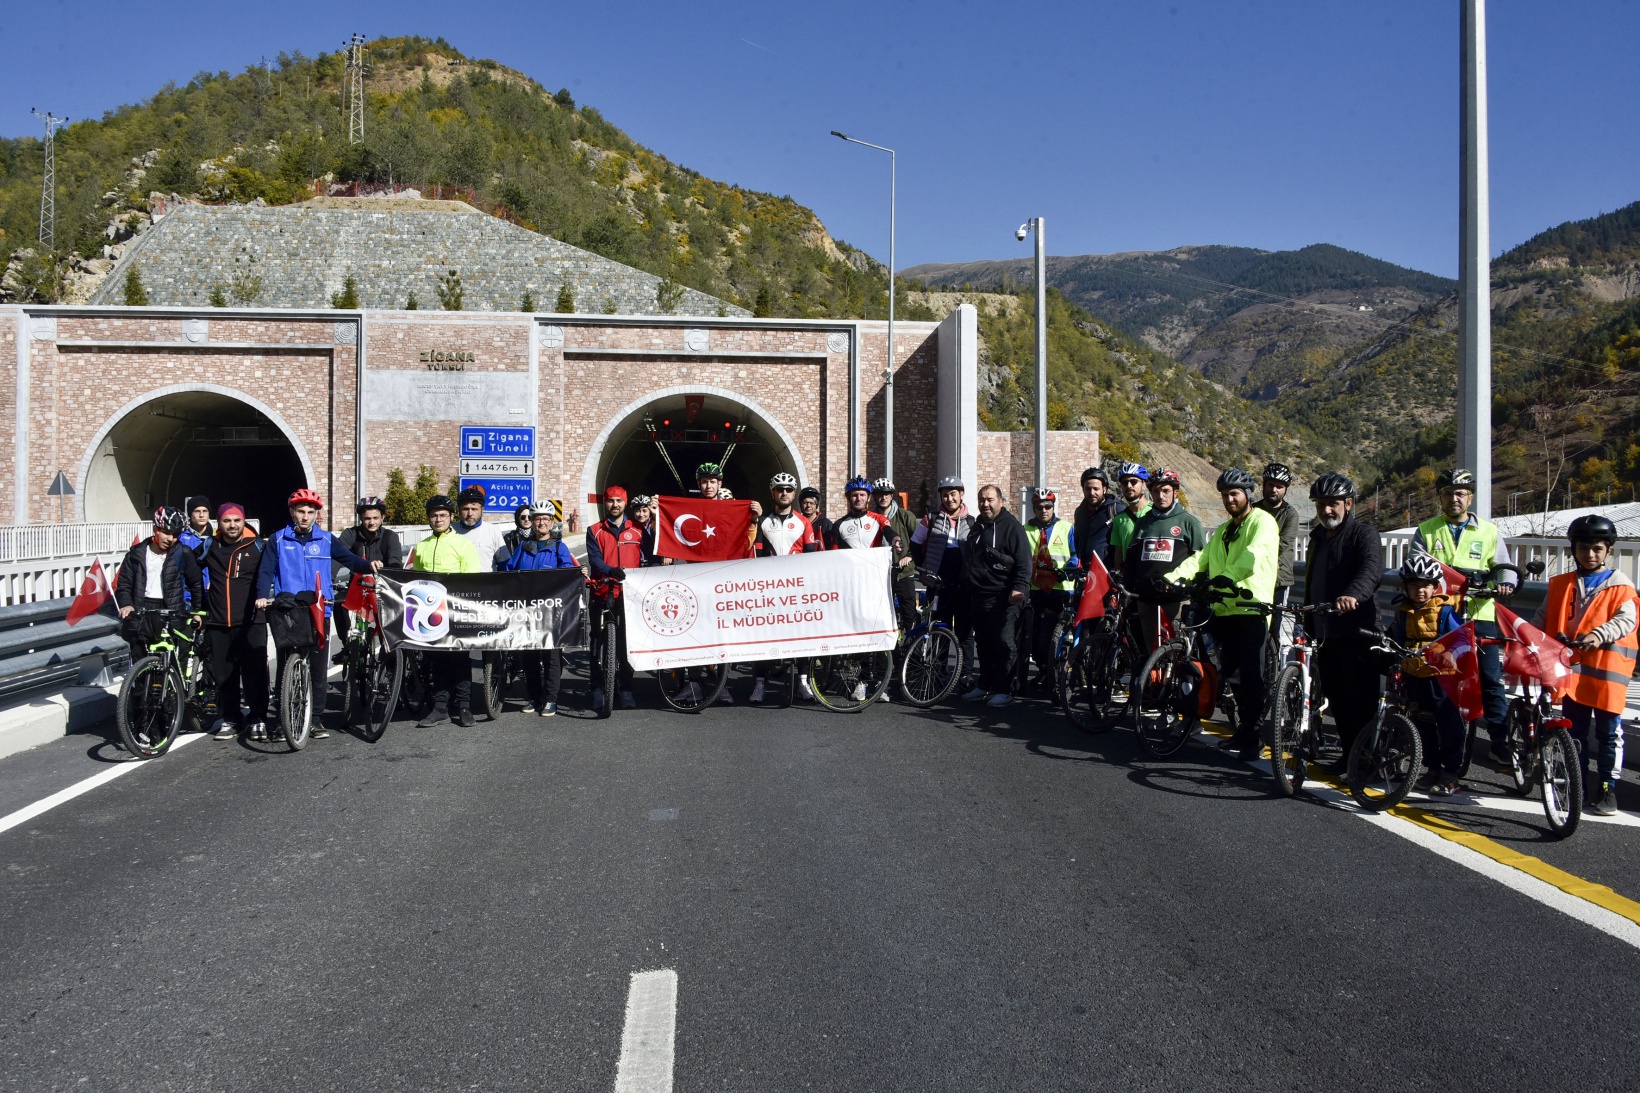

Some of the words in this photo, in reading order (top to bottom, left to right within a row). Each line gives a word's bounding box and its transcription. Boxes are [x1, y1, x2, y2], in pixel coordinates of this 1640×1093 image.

[419, 349, 476, 363] ZİGANA
[427, 362, 465, 371] TÜNELİ
[488, 432, 529, 442] Zigana
[489, 443, 528, 452] Tüneli
[475, 463, 518, 472] 14476m
[490, 483, 514, 491] Açılış
[487, 495, 529, 507] 2023
[714, 576, 805, 594] GÜMÜŞHANE
[530, 597, 563, 609] SPOR
[715, 595, 776, 612] GENÇLİK
[779, 595, 798, 606] VE
[801, 591, 840, 605] SPOR
[453, 611, 543, 622] FEDERSYONU
[717, 616, 729, 629] İL
[733, 608, 824, 628] MÜDÜRLÜĞÜ
